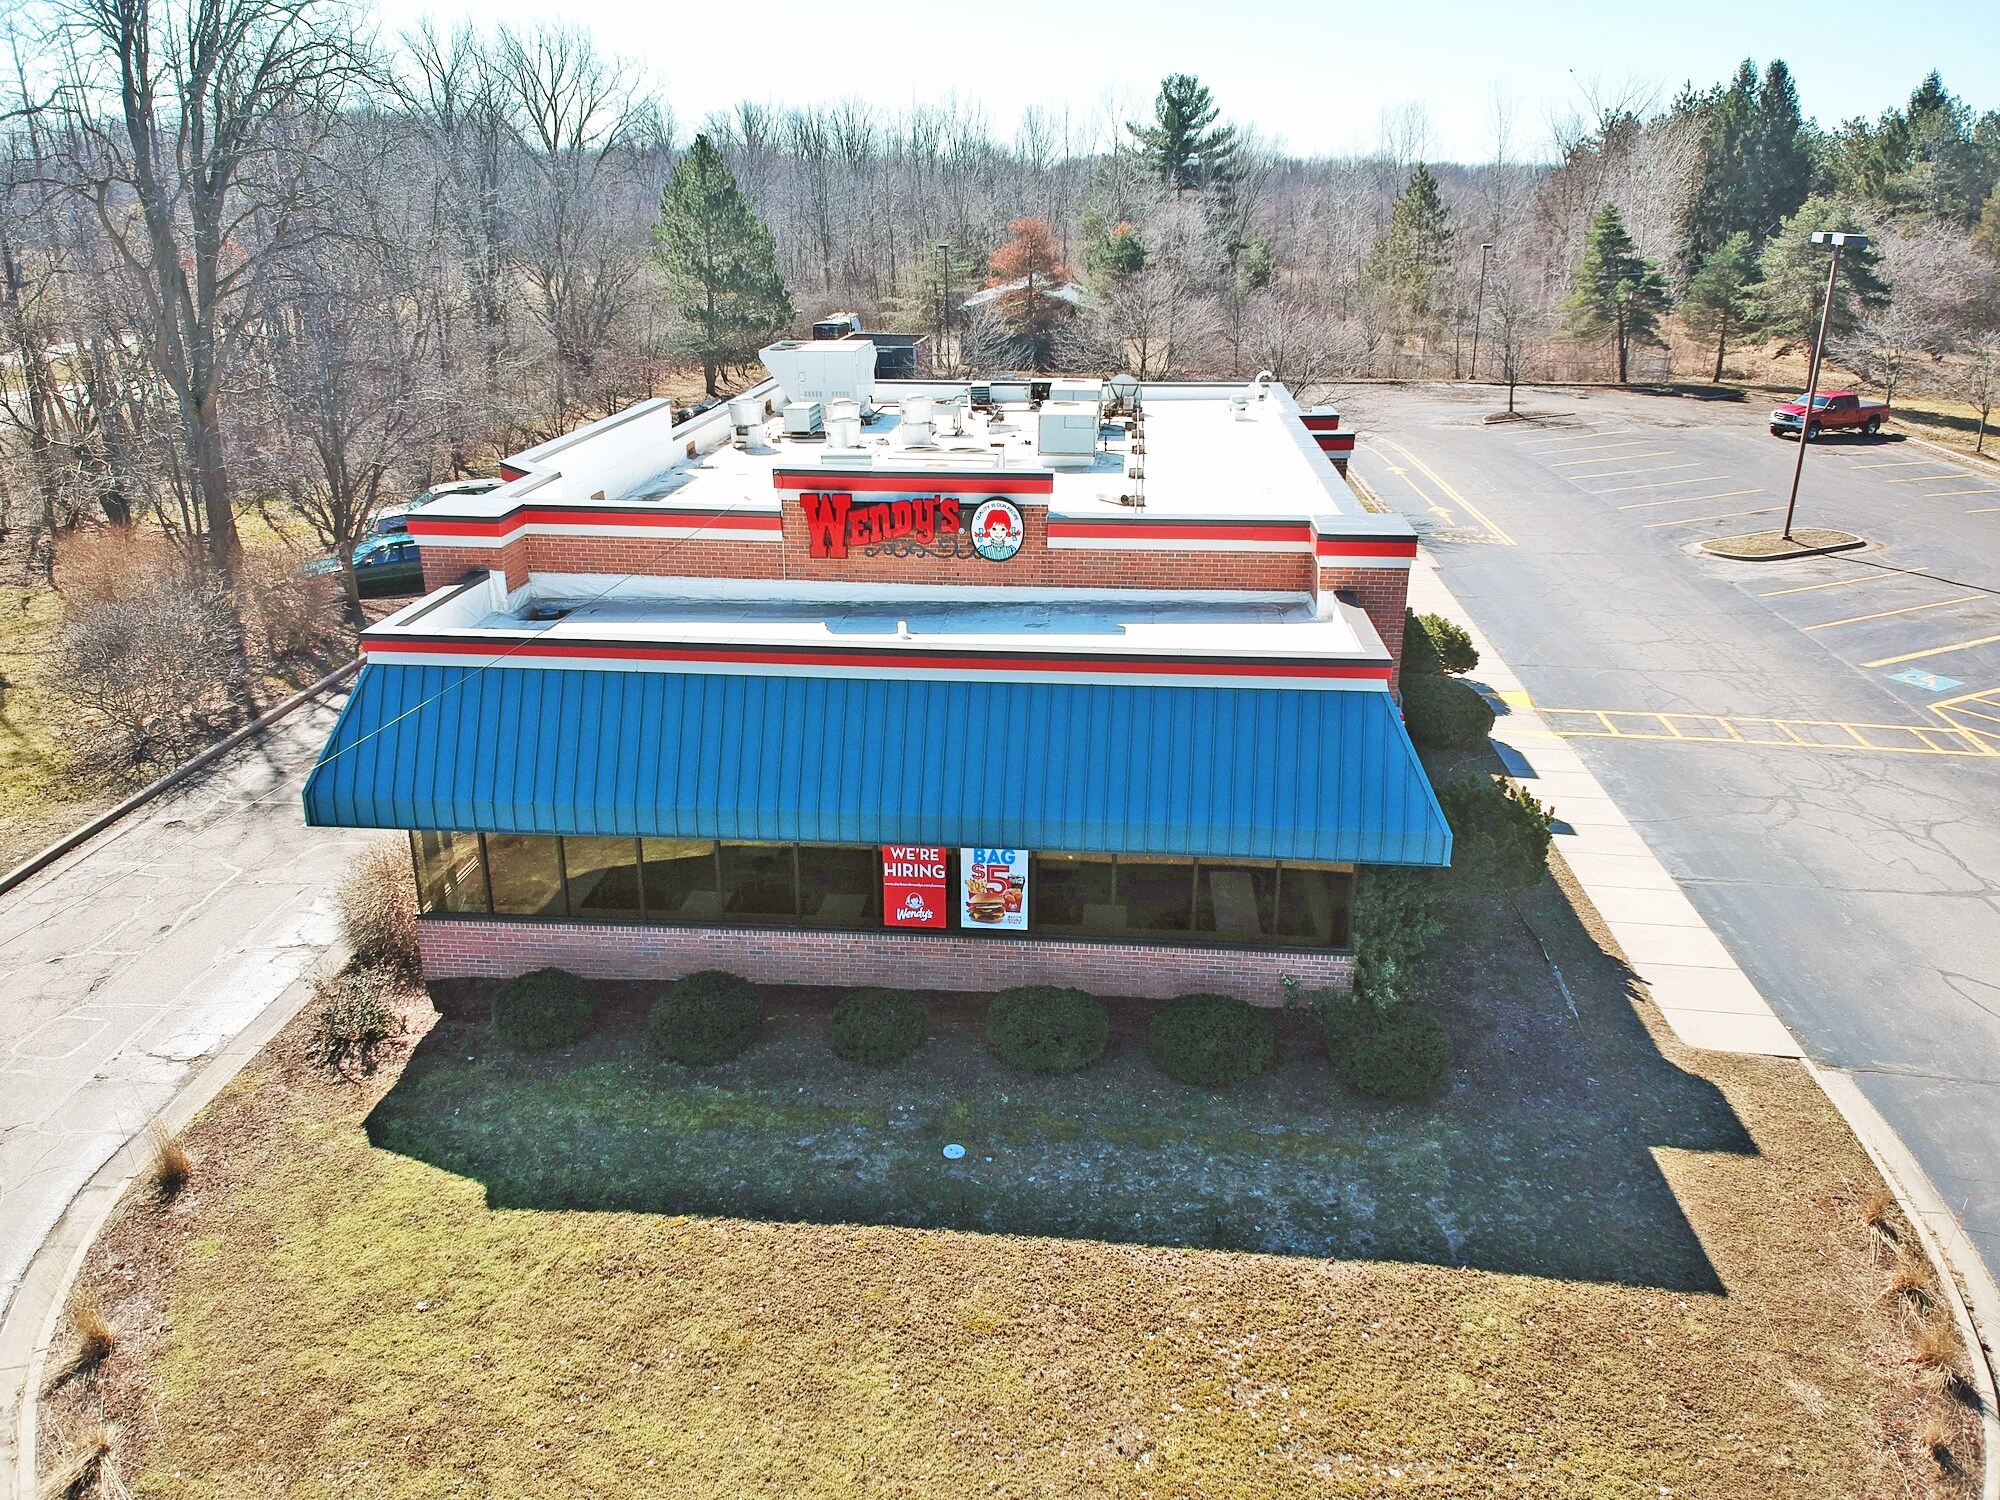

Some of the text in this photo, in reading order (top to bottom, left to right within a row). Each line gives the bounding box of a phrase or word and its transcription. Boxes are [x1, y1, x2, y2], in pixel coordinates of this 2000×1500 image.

[976, 505, 990, 520] QUALITY
[891, 847, 939, 861] WE'RE
[974, 848, 1016, 864] BAG
[884, 863, 945, 878] HIRING
[972, 863, 1012, 895] $5
[897, 907, 933, 921] Wendy's
